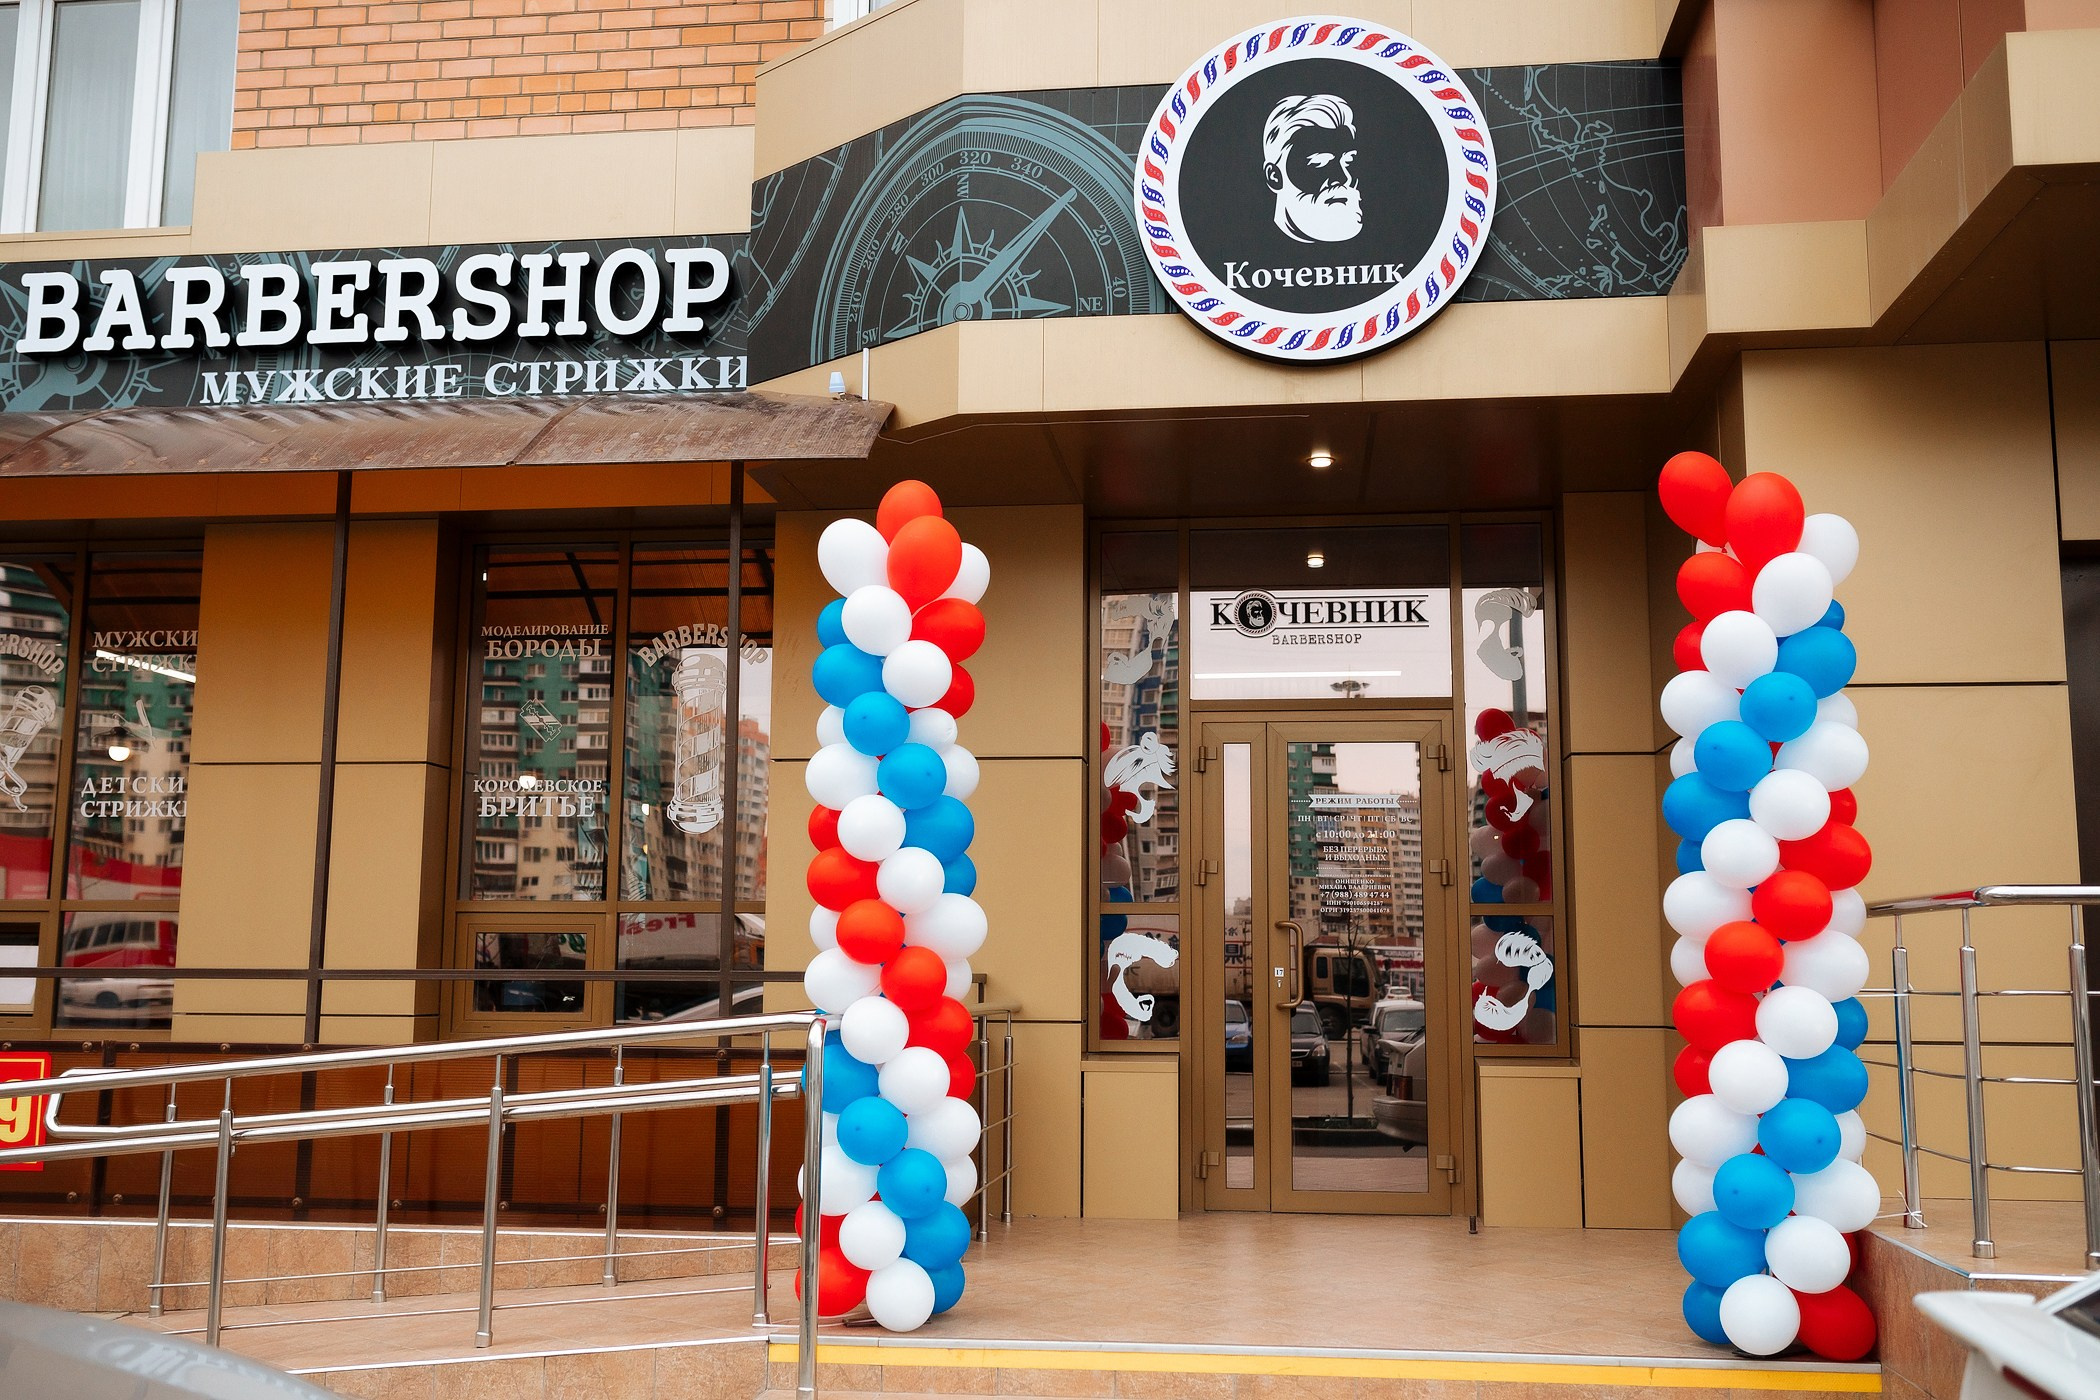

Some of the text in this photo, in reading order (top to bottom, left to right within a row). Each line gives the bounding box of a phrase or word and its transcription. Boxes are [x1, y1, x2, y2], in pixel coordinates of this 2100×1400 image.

[958, 149, 992, 166] 320
[1010, 156, 1043, 180] 340
[920, 161, 945, 188] 300
[887, 192, 911, 223] 280
[1095, 223, 1113, 247] 20
[862, 238, 881, 272] 260
[1112, 275, 1127, 298] 40
[1223, 260, 1405, 290] Кочевник
[16, 247, 731, 354] BARBERSHOP
[848, 291, 863, 324] 240
[1078, 296, 1103, 313] NE
[200, 364, 464, 405] МУЖСКИЕ
[485, 355, 748, 395] СТРИЖКИ
[480, 624, 609, 638] МОДЕЛИРОВАНИЕ
[1272, 633, 1363, 645] BARBERSHOP
[487, 638, 602, 662] БОРОДЫ
[637, 623, 769, 667] BARBERSOP
[478, 796, 596, 818] БРИТЬЕ
[1315, 797, 1394, 805] РЕЖИМ РАБОТЫ
[1324, 830, 1351, 839] 10:00
[1352, 832, 1365, 840] до
[1366, 830, 1396, 839] 21:00
[1333, 854, 1387, 862] ВЫХОДНЫХ
[1331, 890, 1353, 900] (988)
[1354, 891, 1368, 899] 489
[1369, 891, 1380, 899] 47
[1380, 891, 1390, 899] 44
